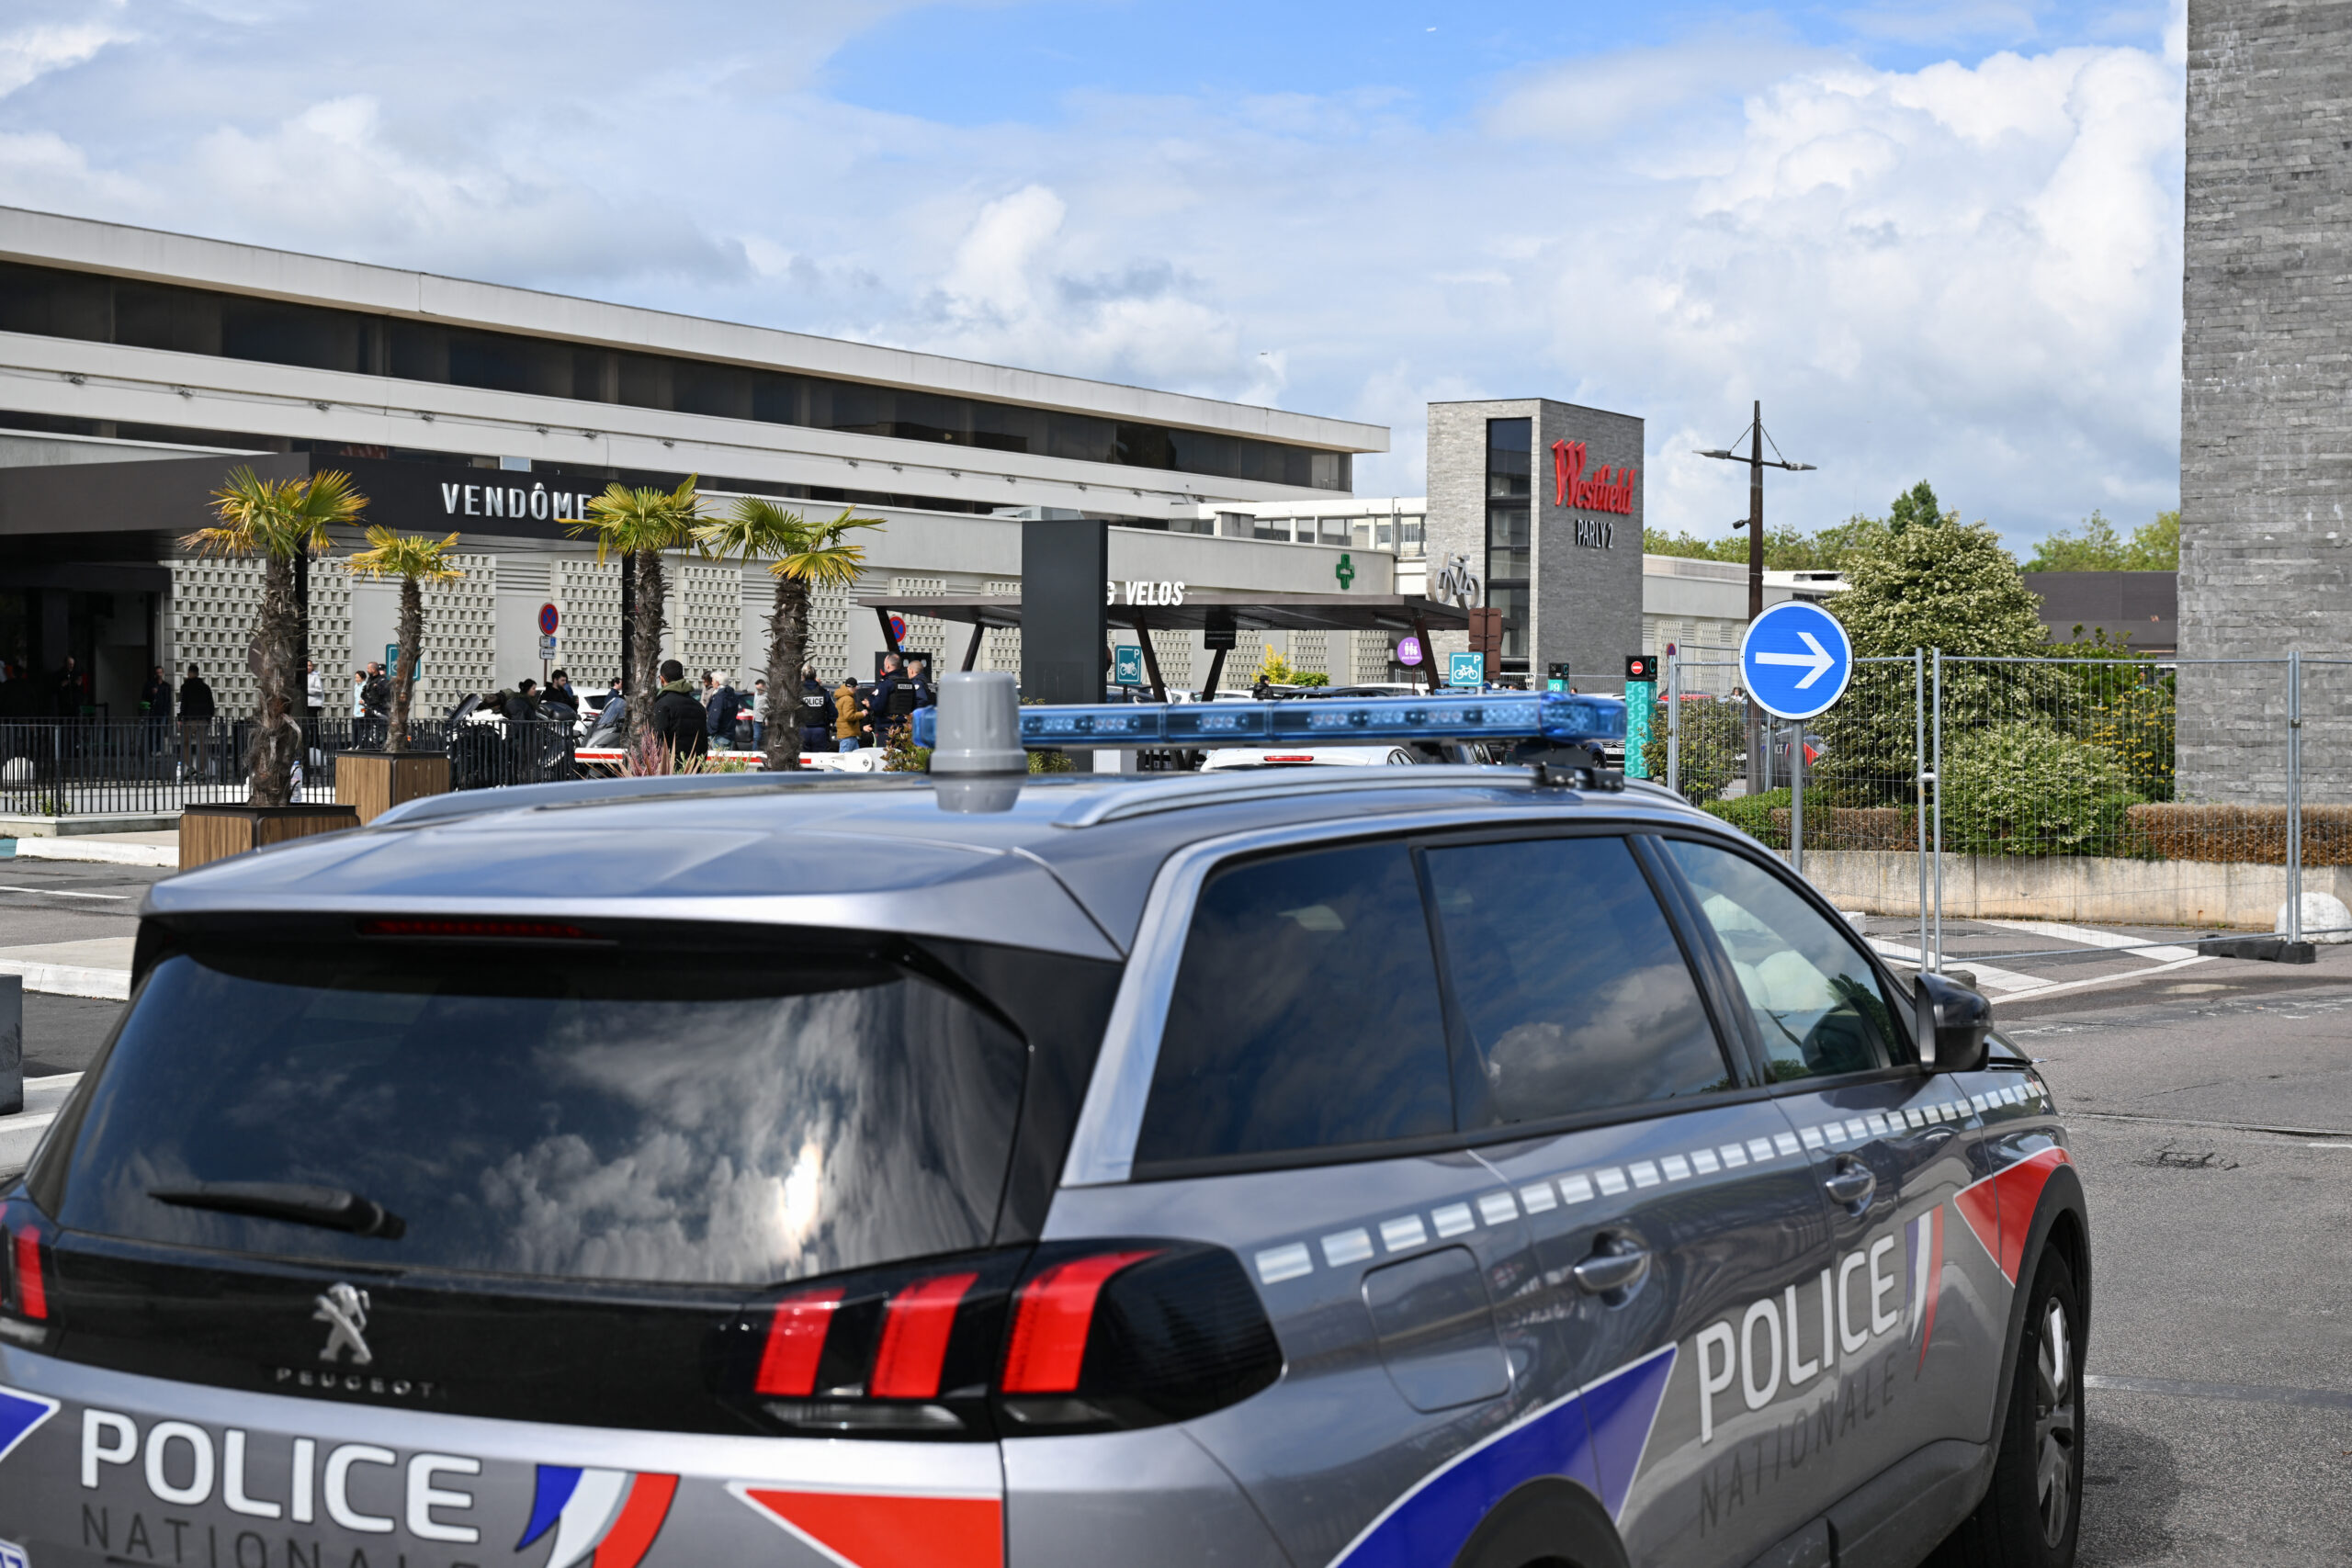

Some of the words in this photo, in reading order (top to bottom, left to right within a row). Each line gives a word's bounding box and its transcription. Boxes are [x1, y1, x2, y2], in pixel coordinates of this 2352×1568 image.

[1552, 439, 1636, 514] Westfield
[441, 482, 593, 521] VENDÔME
[1577, 519, 1606, 548] PARLY
[1608, 523, 1614, 548] 2
[1125, 581, 1185, 605] VELOS
[1134, 649, 1140, 659] P
[1473, 654, 1482, 664] P
[803, 697, 823, 705] OLICE
[1696, 1235, 1898, 1445] POLICE
[277, 1367, 434, 1398] PEUGEOT
[1701, 1351, 1897, 1540] NATIONALE
[81, 1408, 481, 1543] POLICE
[83, 1503, 480, 1568] NATION
